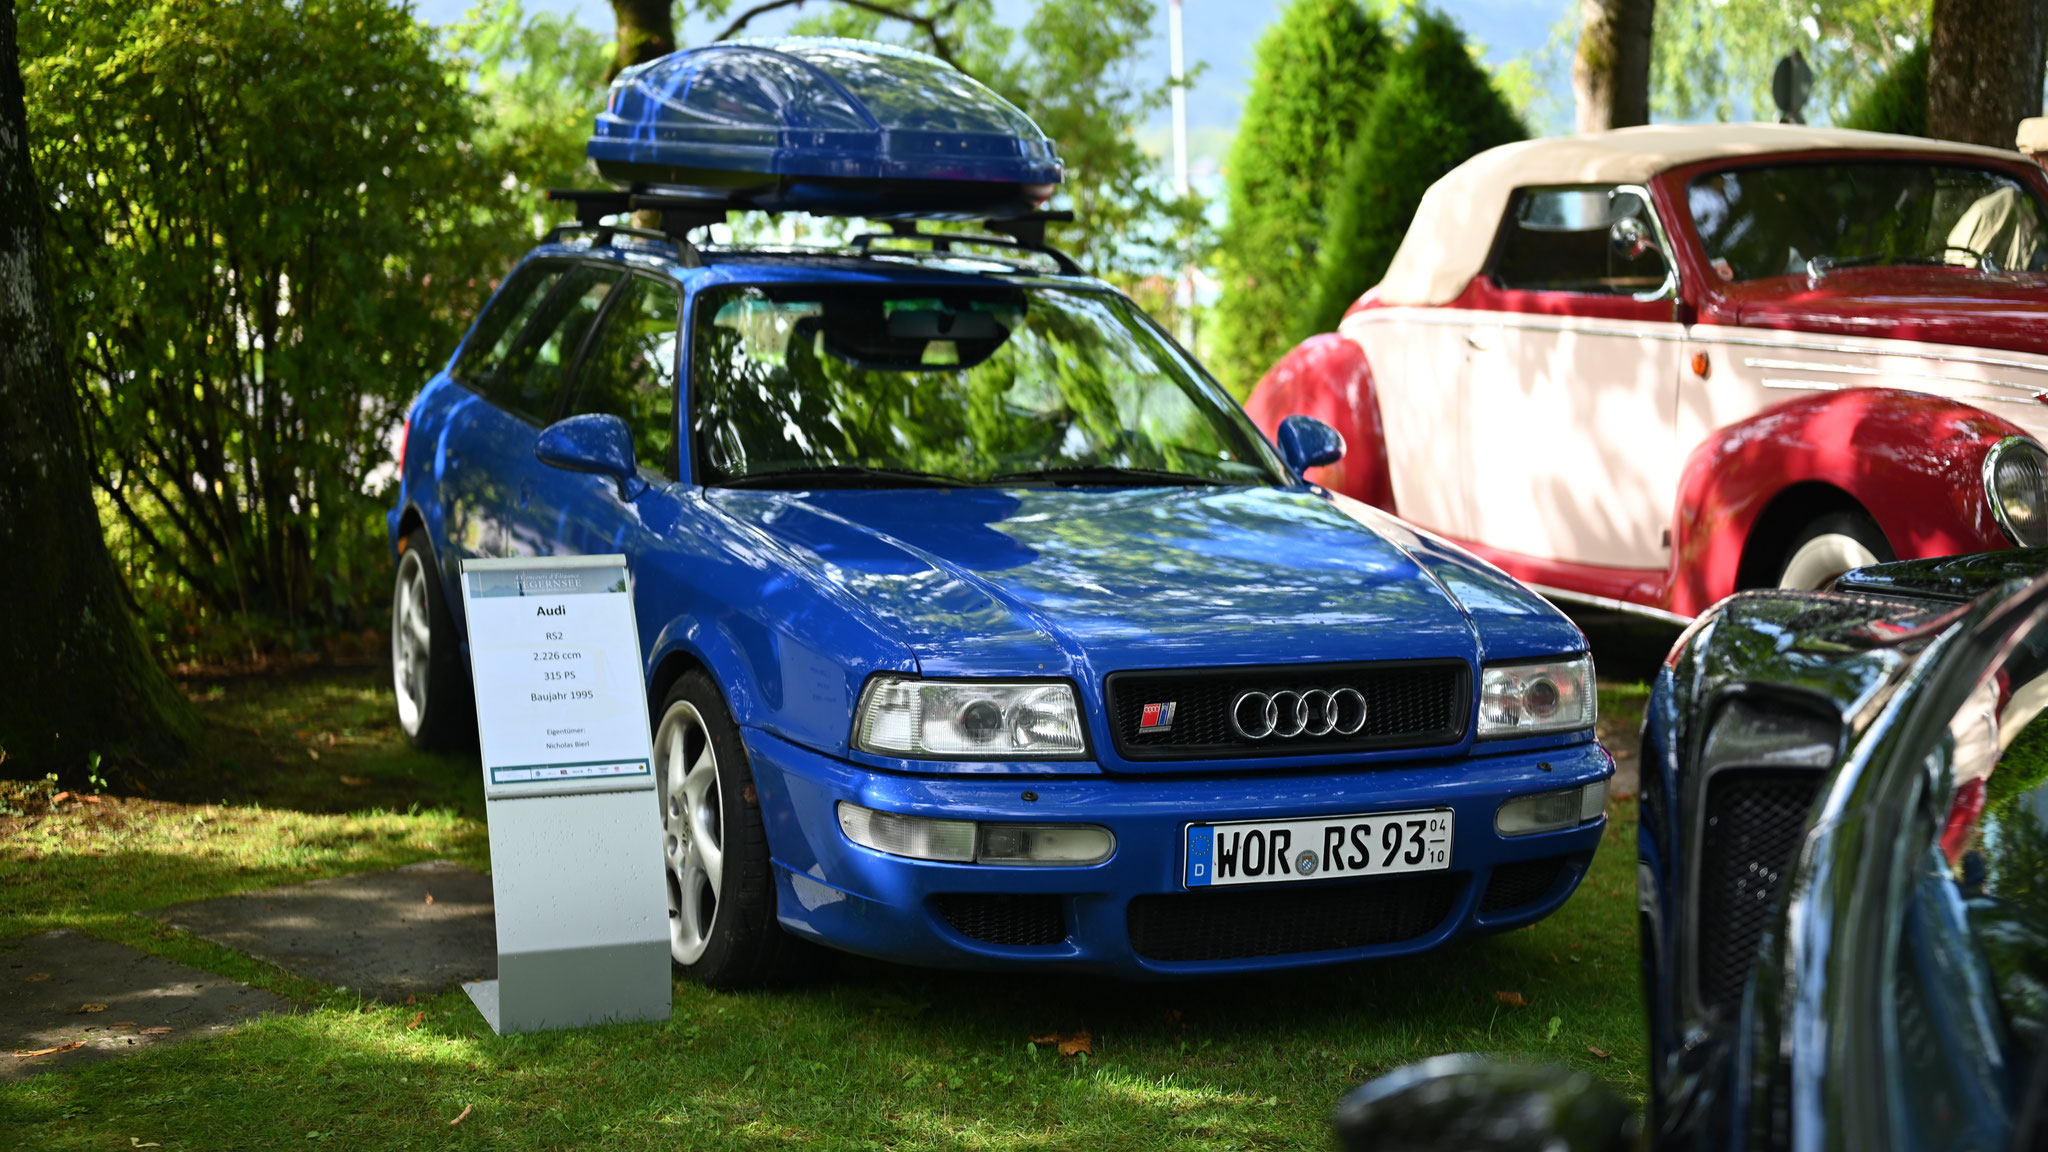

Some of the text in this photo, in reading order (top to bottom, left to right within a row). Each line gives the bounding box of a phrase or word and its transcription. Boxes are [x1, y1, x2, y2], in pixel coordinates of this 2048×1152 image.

[514, 579, 582, 589] TEGERNSEE
[536, 604, 567, 616] Audi
[545, 631, 564, 641] RS2
[532, 651, 582, 661] 2.226 ccm
[544, 670, 577, 681] 315 PS
[530, 690, 594, 703] Baujahr 1995
[546, 728, 586, 736] Eigentümer:
[1430, 818, 1446, 831] 04
[1216, 829, 1292, 878] WOR
[1322, 824, 1371, 872] RS
[1381, 819, 1427, 867] 93
[1430, 850, 1445, 864] 10
[1194, 863, 1205, 877] D
